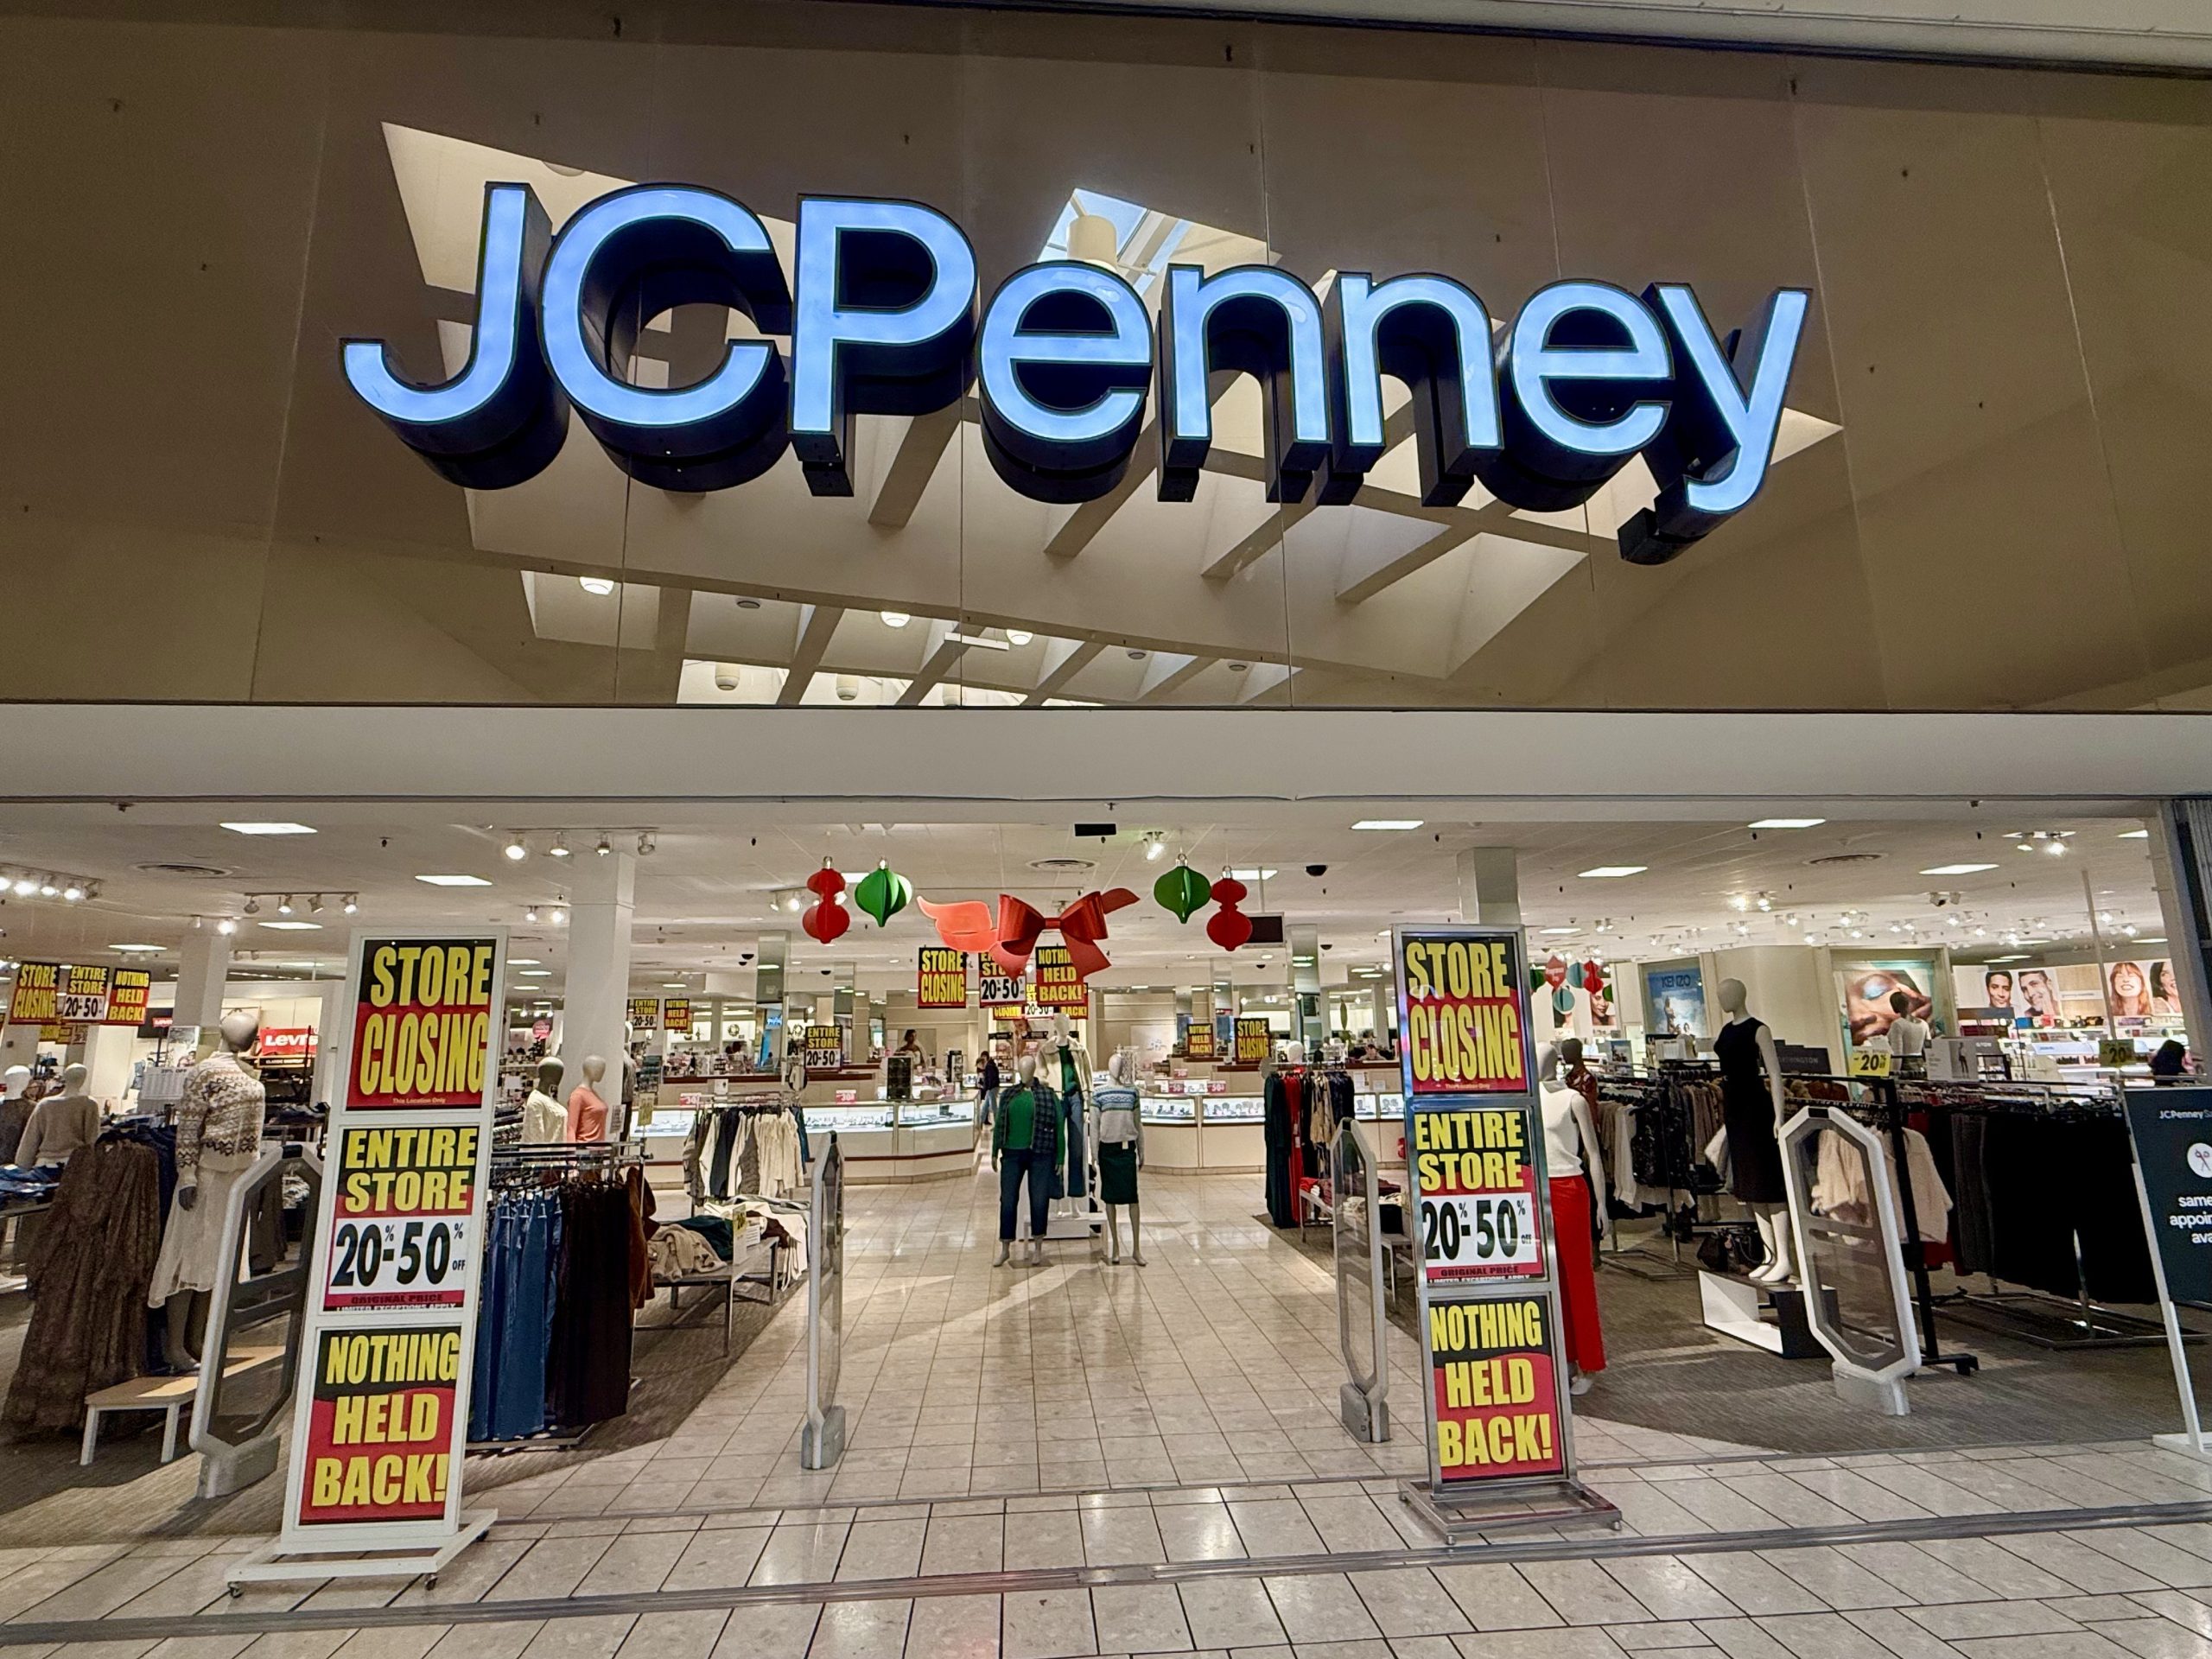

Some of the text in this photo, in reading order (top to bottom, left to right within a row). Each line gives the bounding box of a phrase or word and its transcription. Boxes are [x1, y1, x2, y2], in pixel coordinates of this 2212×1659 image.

[342, 184, 1809, 512] JCPenney
[921, 950, 963, 972] STORE
[1039, 949, 1071, 964] NOTHI
[20, 963, 58, 988] STORE
[71, 965, 107, 981] ENTIRE
[115, 970, 149, 988] NOTHING
[370, 945, 493, 1007] STORE
[1043, 967, 1077, 982] HELD
[1406, 942, 1510, 999] STORE
[1661, 975, 1691, 988] KENZO
[68, 980, 105, 995] STORE
[116, 988, 144, 1004] HELD
[920, 973, 964, 1003] CLOSING
[1039, 985, 1083, 1001] BACK!
[13, 988, 57, 1019] CLOSING
[108, 1006, 146, 1021] BACK!
[807, 1027, 841, 1038] ENTIRE
[1237, 1020, 1268, 1037] STORE
[808, 1038, 840, 1048] STORE
[1237, 1038, 1269, 1059] CLOSING
[1410, 1003, 1522, 1081] CLOSING
[359, 1012, 491, 1096] CLOSING
[2159, 1109, 2203, 1120] JCPenney
[1414, 1112, 1524, 1150] ENTIRE
[346, 1128, 478, 1168] ENTIRE
[1418, 1152, 1524, 1192] STORE
[346, 1171, 469, 1213] STORE
[2177, 1195, 2212, 1207] same
[452, 1259, 466, 1271] OFF
[1440, 1265, 1520, 1277] ORIGINAL PRICE
[351, 1294, 443, 1305] ORIGINAL PRICE
[1429, 1300, 1543, 1351] NOTHING
[326, 1332, 461, 1384] NOTHING
[1445, 1358, 1535, 1408] HELD
[333, 1393, 440, 1445] HELD
[1437, 1414, 1553, 1467] BACK!
[311, 1453, 450, 1507] BACK!
